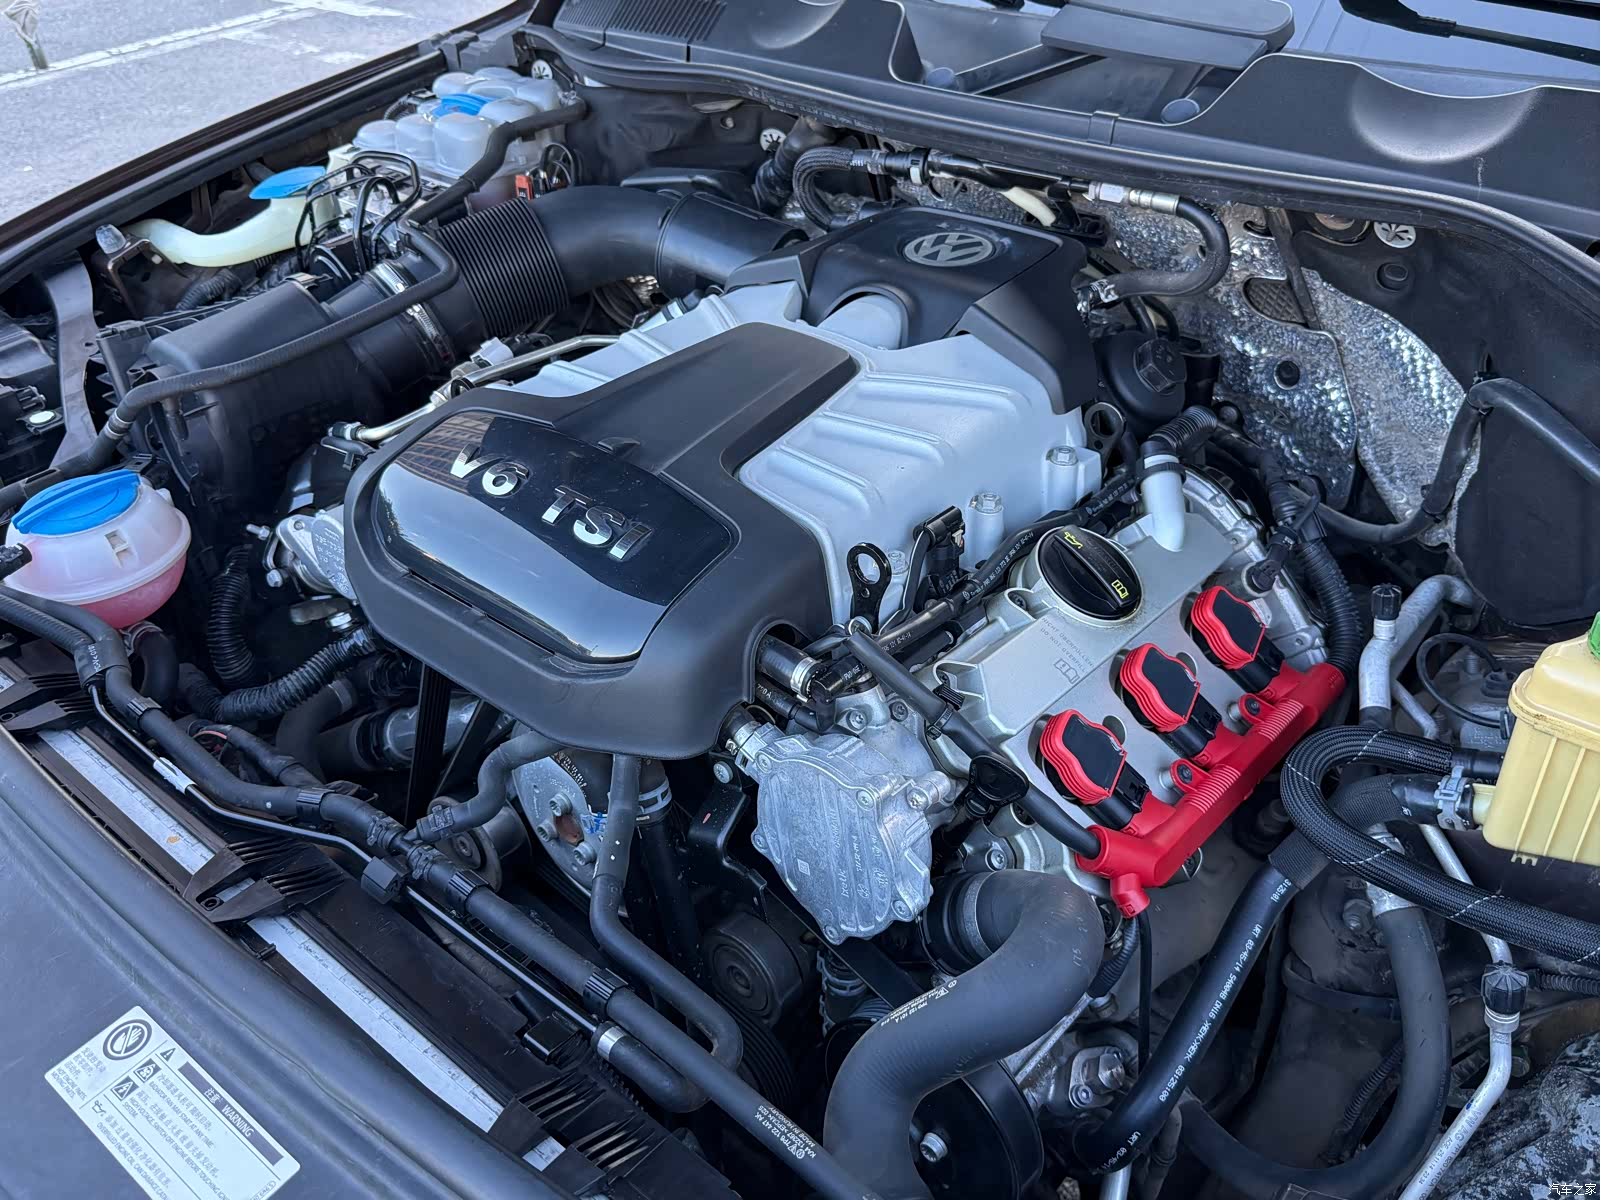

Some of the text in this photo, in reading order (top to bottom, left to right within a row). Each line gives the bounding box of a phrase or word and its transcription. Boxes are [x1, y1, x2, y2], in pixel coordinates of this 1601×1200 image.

[450, 442, 653, 561] V6 TSI
[1049, 636, 1061, 647] NOT
[178, 1112, 192, 1125] START
[219, 1104, 255, 1137] WARNING
[770, 1126, 782, 1137] 122
[1455, 1126, 1468, 1141] AG
[170, 1142, 188, 1159] ENGINE
[183, 1156, 202, 1173] BEFORE
